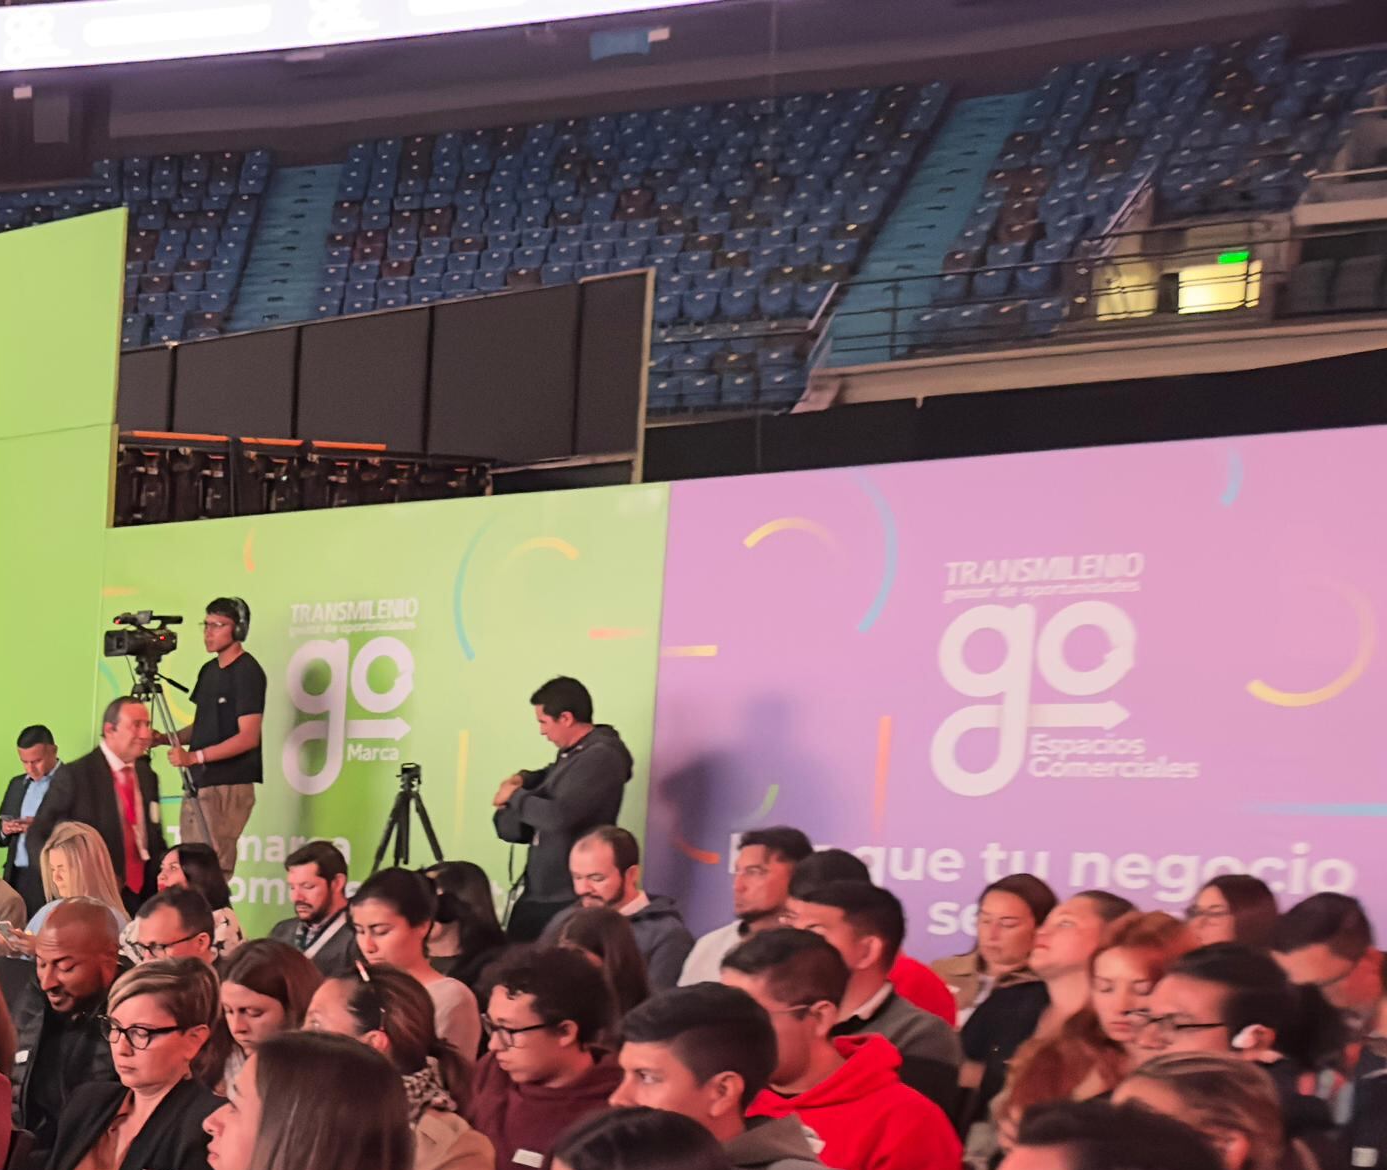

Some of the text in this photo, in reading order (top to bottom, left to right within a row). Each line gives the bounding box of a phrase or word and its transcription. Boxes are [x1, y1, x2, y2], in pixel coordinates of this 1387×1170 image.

[943, 552, 1146, 586] TRANSMILENIO
[289, 597, 419, 625] TRANSMILENIO
[930, 600, 1138, 797] go
[281, 636, 414, 795] go
[347, 743, 400, 762] Marca
[1029, 732, 1147, 760] Espacios
[1028, 754, 1202, 779] Comerciales
